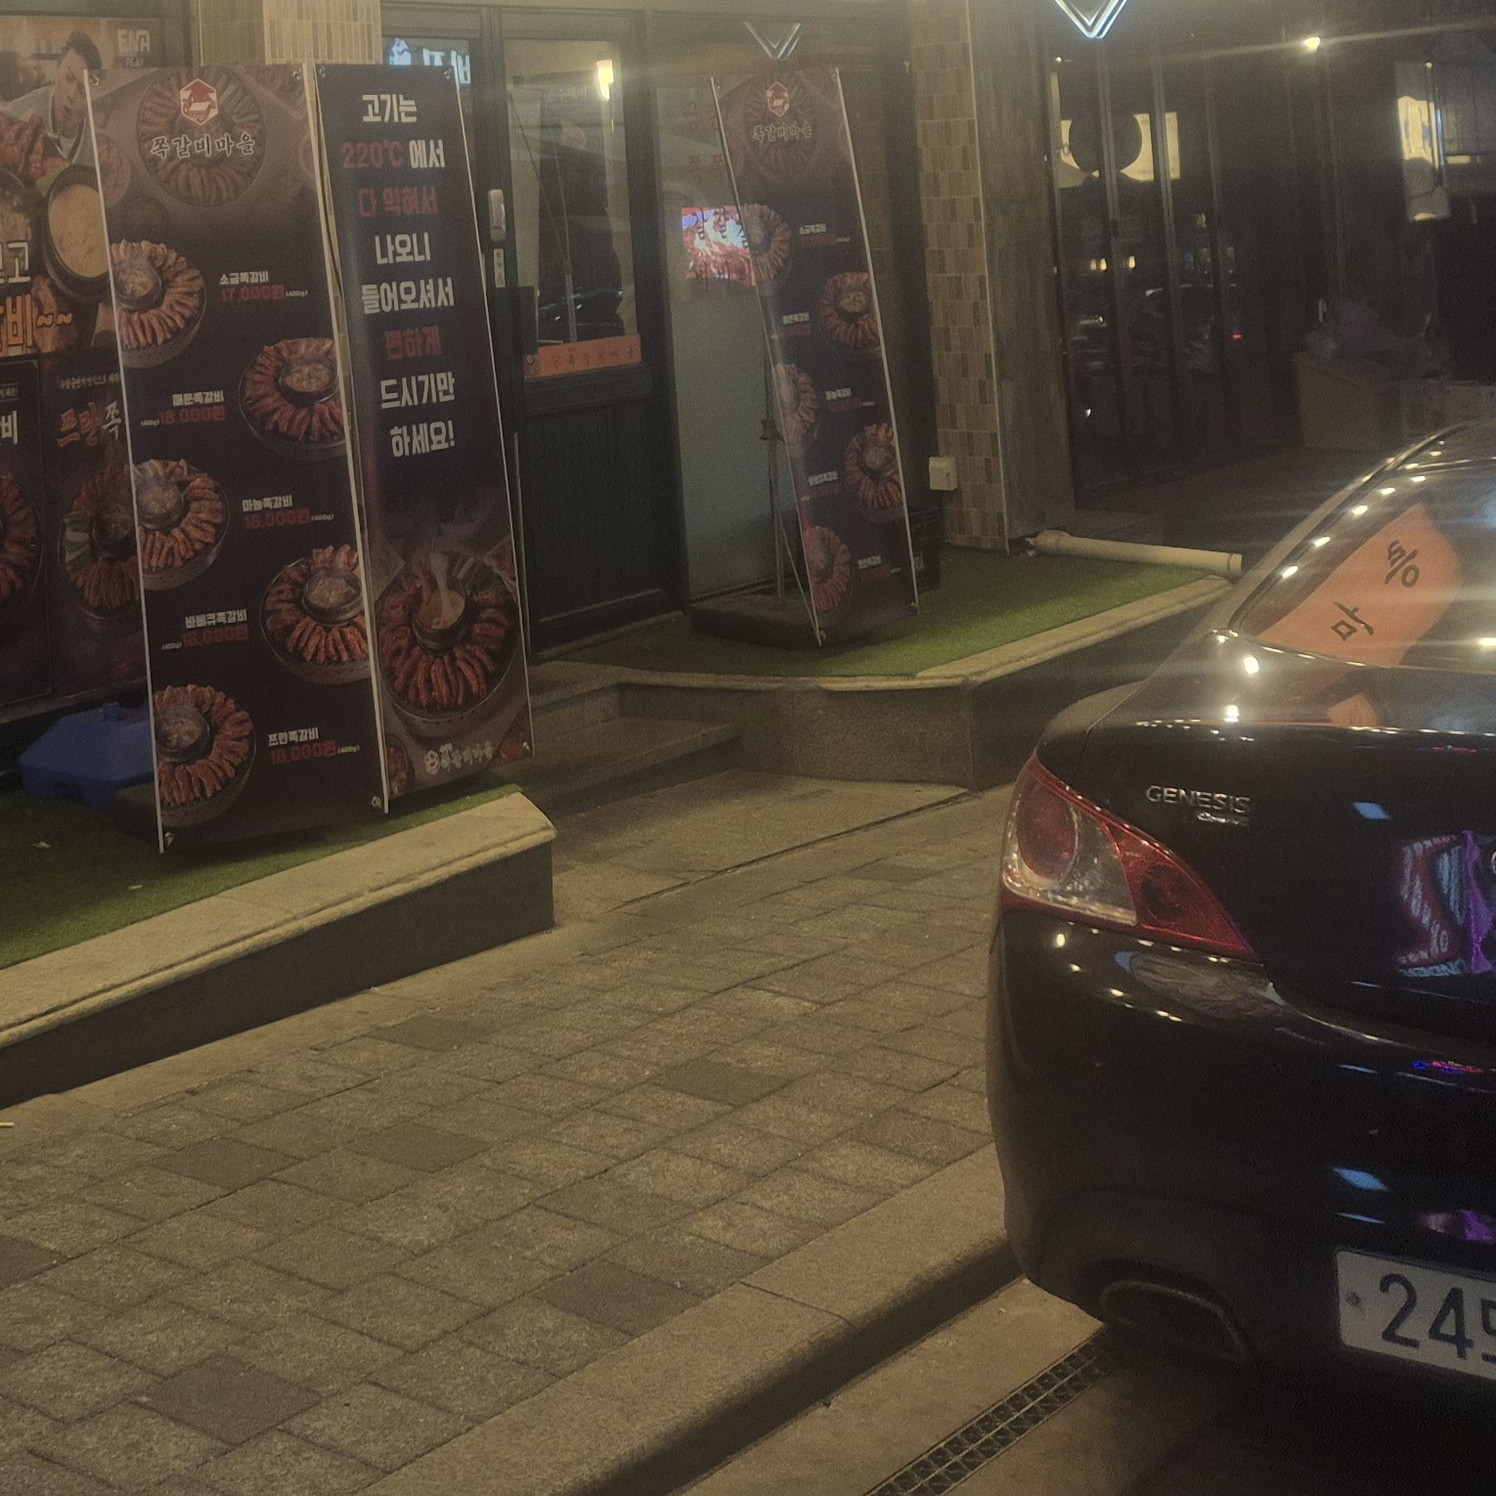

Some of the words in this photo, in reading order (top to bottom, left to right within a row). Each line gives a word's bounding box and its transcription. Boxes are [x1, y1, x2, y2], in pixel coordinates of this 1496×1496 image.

[361, 93, 418, 123] 고기는
[150, 130, 256, 160] 쪽갈비마을
[408, 138, 446, 169] 에서
[374, 231, 432, 266] 나오니
[361, 276, 455, 315] 들어오셔서
[379, 370, 456, 410] 드시기만
[389, 419, 456, 458] 하세요!
[1146, 785, 1251, 814] GENESIS
